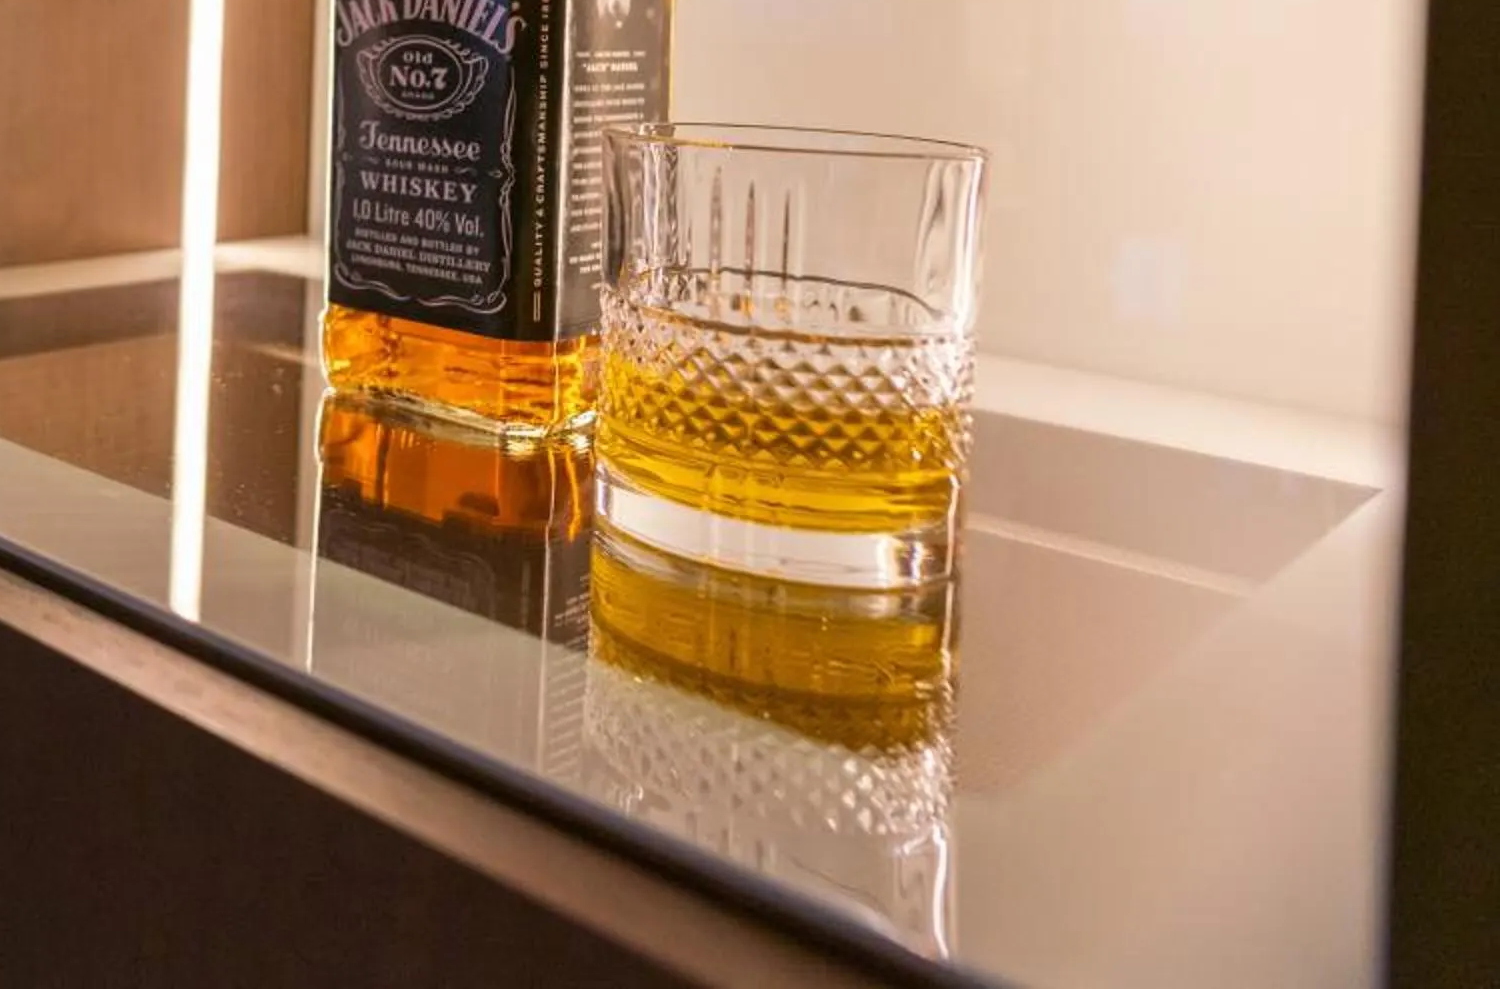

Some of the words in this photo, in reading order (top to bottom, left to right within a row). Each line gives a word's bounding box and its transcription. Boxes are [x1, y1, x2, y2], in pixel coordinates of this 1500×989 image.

[402, 50, 433, 65] Old
[539, 24, 549, 69] SINCE
[389, 66, 448, 90] No.7
[359, 120, 481, 161] Tennessee
[536, 74, 548, 204] CRAFTSMANSHIP
[360, 170, 478, 204] WHISKEY
[374, 201, 410, 226] Litre
[414, 208, 451, 234] 40%
[454, 213, 485, 238] Vol.
[346, 239, 372, 253] JACK
[373, 243, 416, 260] DANIEL
[419, 251, 491, 273] DISTILLERY
[400, 235, 419, 247] AND
[466, 244, 480, 256] BY
[533, 222, 544, 288] QUALITY
